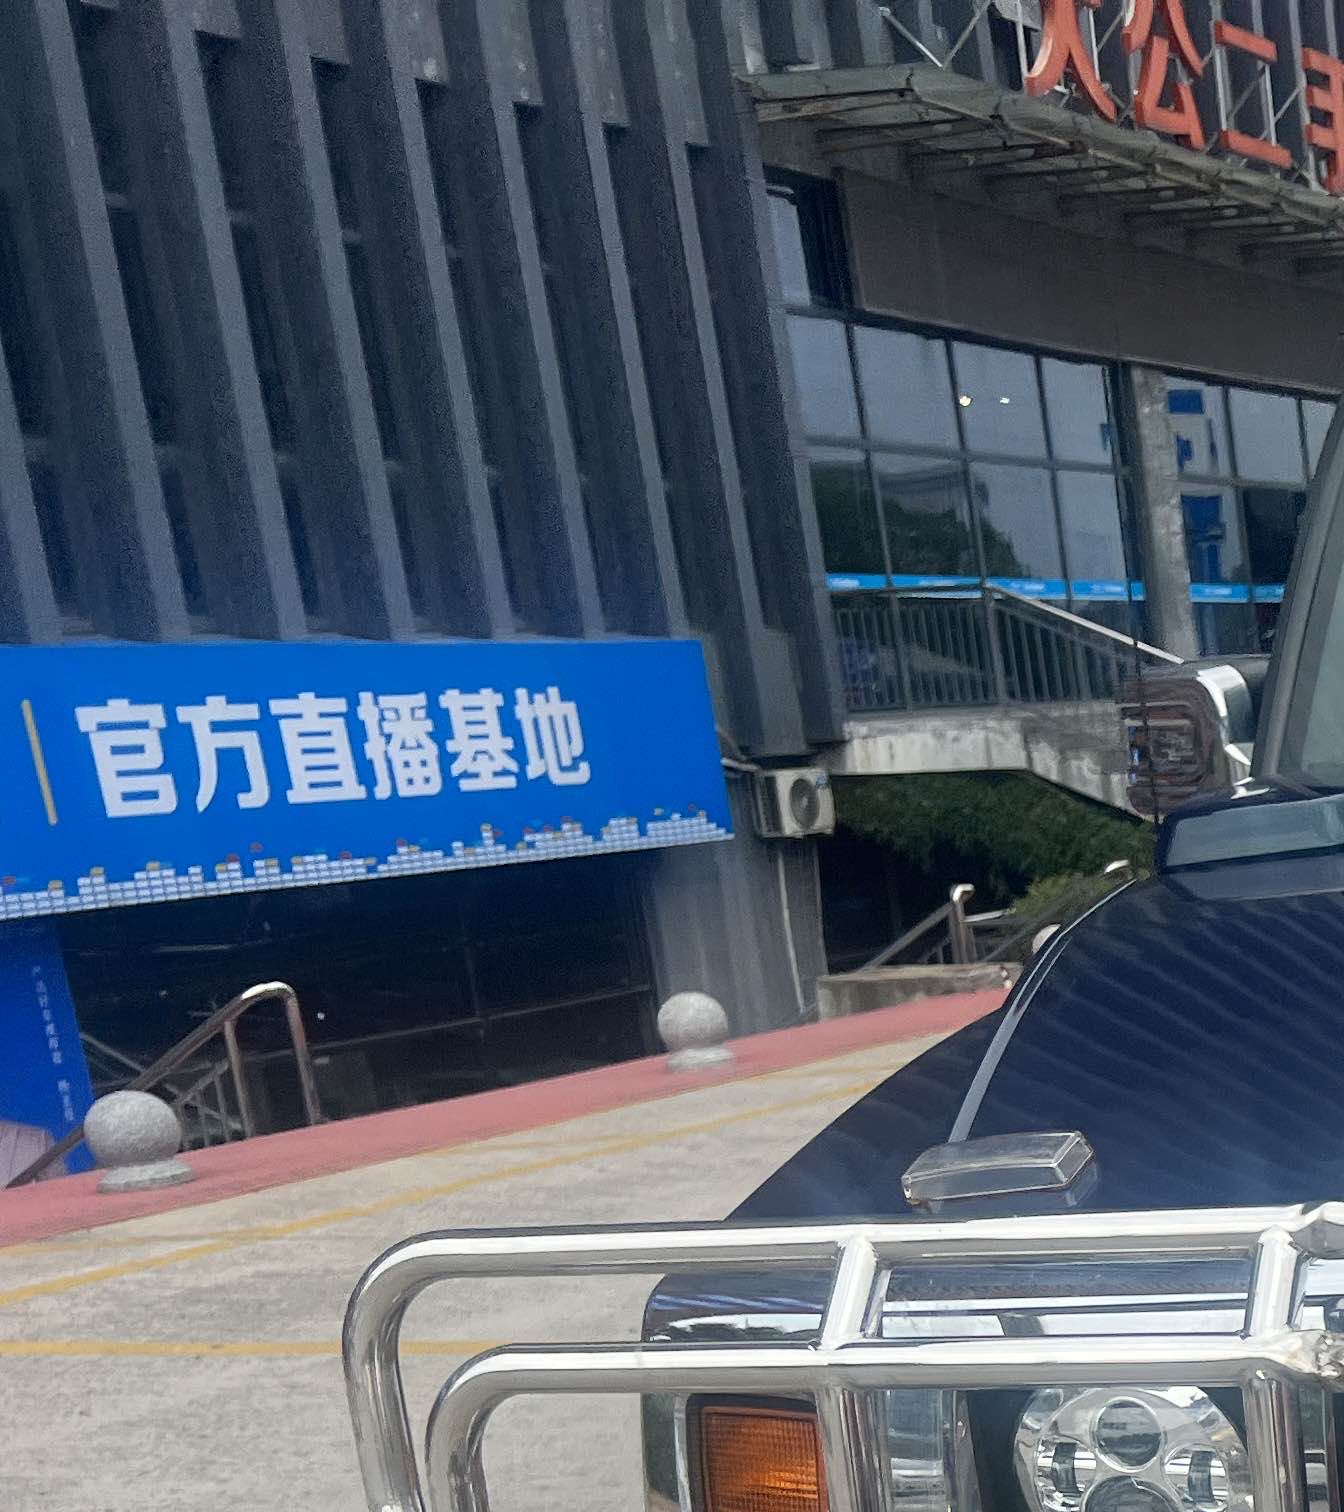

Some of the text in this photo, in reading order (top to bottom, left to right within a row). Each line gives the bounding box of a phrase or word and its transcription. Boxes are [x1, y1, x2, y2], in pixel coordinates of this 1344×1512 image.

[76, 686, 592, 818] 官方直播基地
